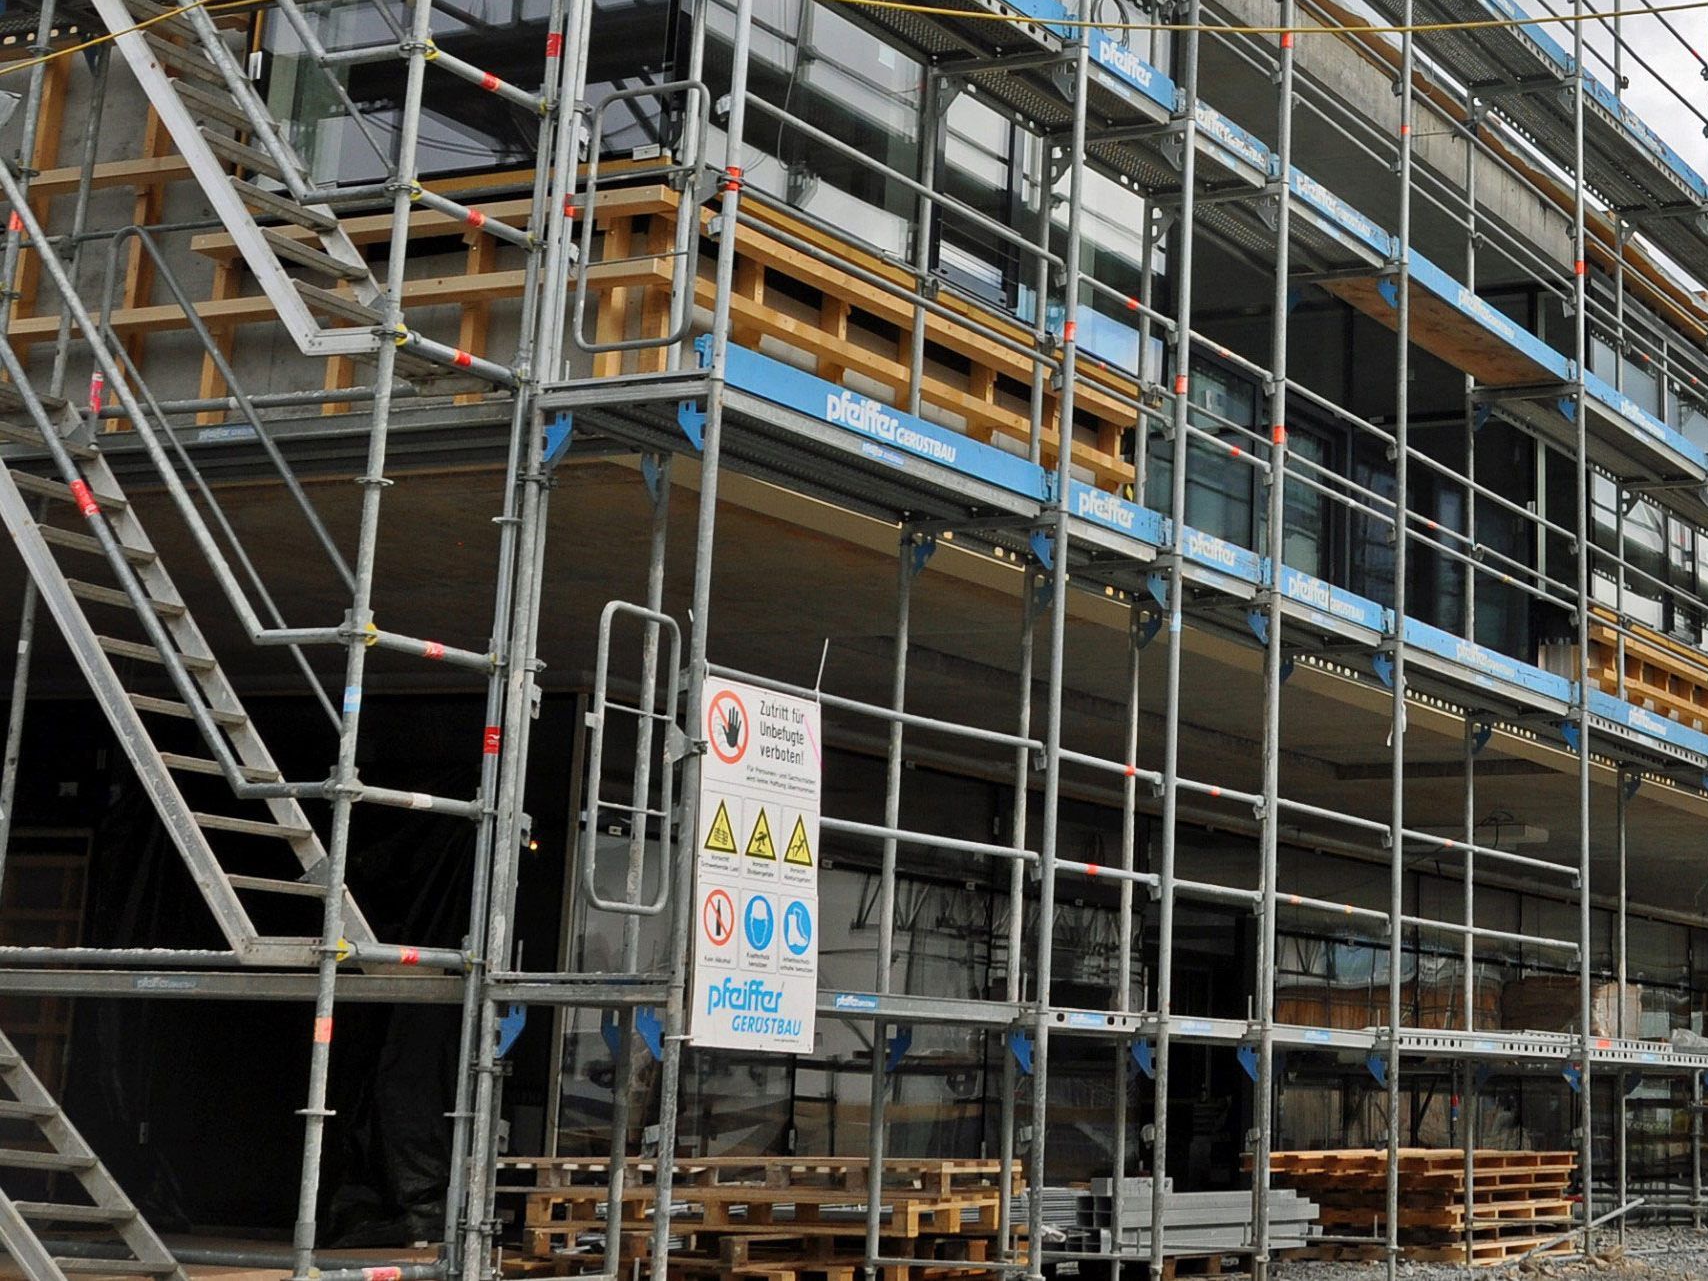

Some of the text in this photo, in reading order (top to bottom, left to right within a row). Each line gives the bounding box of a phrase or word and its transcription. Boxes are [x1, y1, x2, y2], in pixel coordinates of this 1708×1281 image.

[1100, 40, 1151, 88] pfeiffer
[826, 390, 957, 463] pfeiffer GERÜSTBAU
[1079, 490, 1135, 529] pfeiffer
[1189, 530, 1237, 567] pfeiffer
[760, 700, 805, 724] Zutritt für
[760, 720, 805, 747] Unbefugte
[760, 745, 804, 766] verboten!
[707, 976, 784, 1015] pfeiffer
[731, 1015, 802, 1036] GERÜSTBAU
